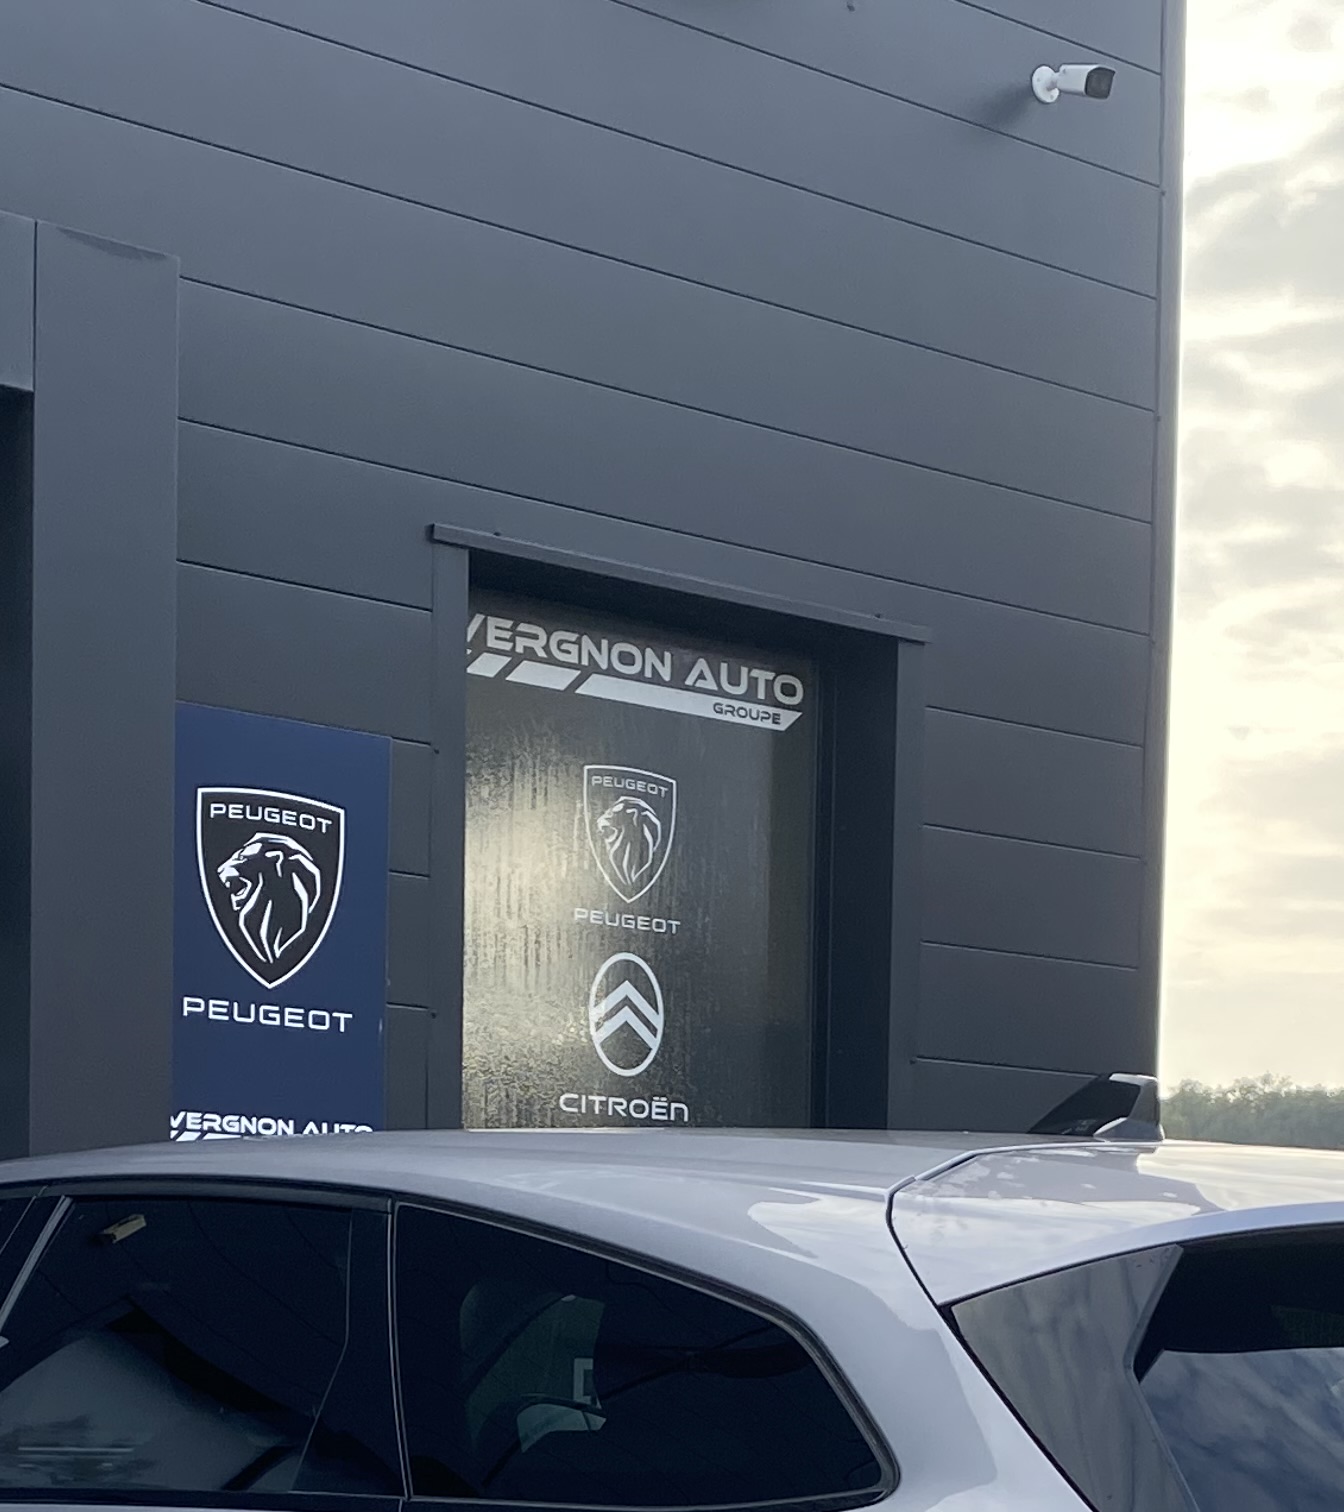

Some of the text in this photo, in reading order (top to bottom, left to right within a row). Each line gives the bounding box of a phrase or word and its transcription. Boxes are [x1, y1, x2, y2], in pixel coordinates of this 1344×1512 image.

[684, 657, 804, 705] AUTO
[713, 702, 781, 725] GROUPE
[591, 774, 669, 798] PEUGEOT
[209, 802, 333, 834] PEUGEOT
[573, 906, 681, 935] PEUGEOT
[183, 995, 353, 1033] PEUGEOT
[558, 1092, 689, 1123] CITROËN
[170, 1110, 294, 1136] VERGNON
